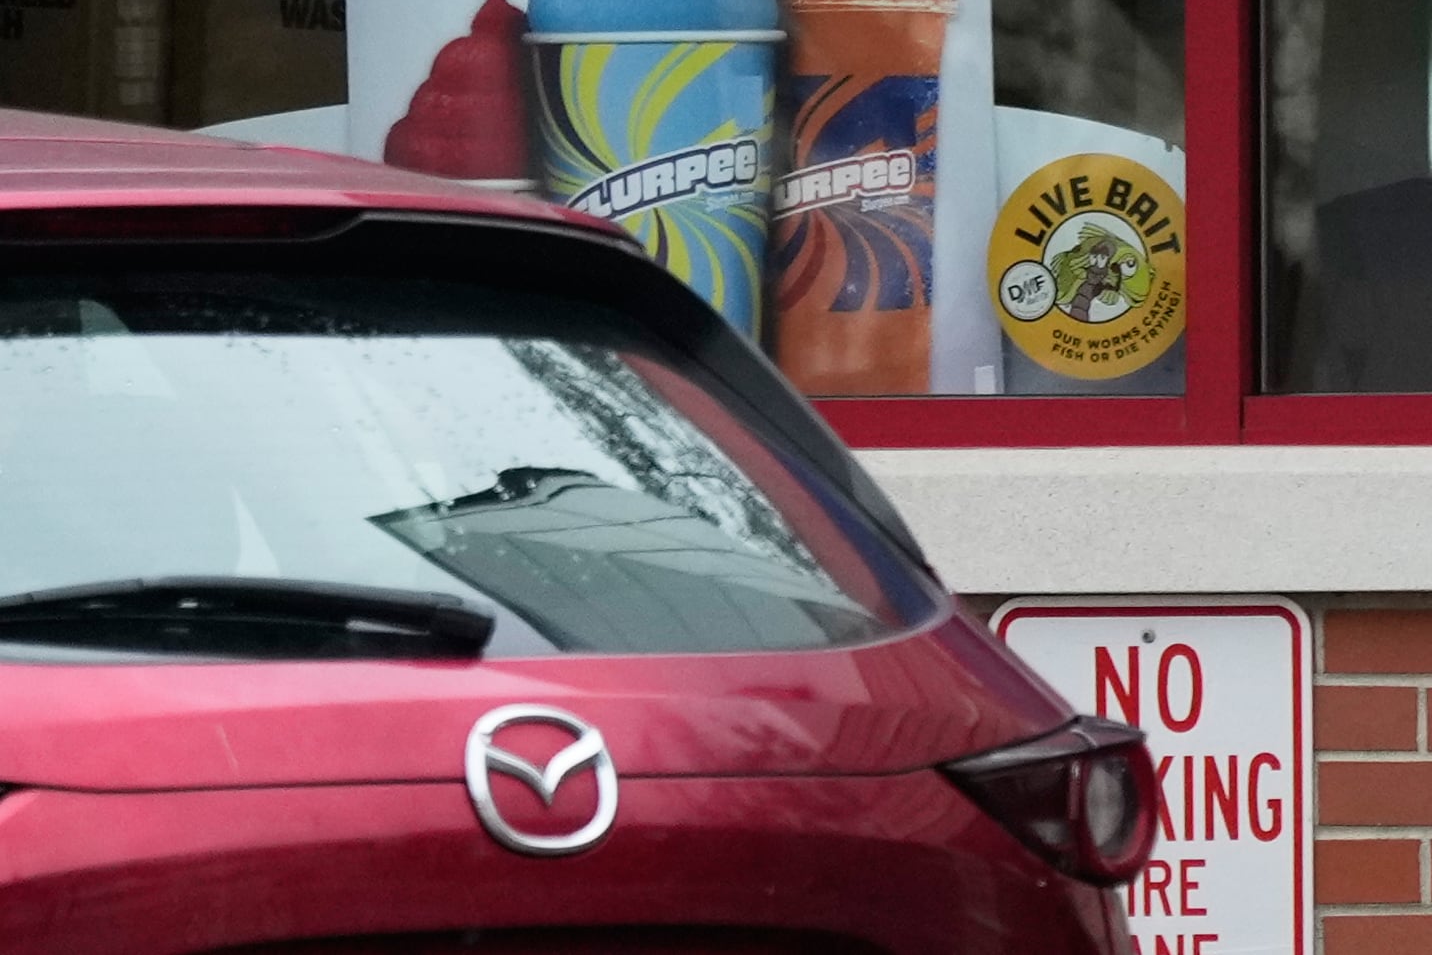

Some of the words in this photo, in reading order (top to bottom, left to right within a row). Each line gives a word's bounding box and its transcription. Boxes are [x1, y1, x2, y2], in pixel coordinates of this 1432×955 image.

[1015, 175, 1093, 247] LIVE
[1104, 176, 1181, 255] BAIT
[1052, 328, 1081, 347] OUR
[1088, 327, 1141, 350] WORMS
[1142, 281, 1172, 326] CATCH
[1052, 343, 1084, 362] FISH
[1091, 349, 1110, 363] OR
[1116, 343, 1140, 359] DIE
[1142, 290, 1182, 344] TRYING!
[1095, 643, 1203, 734] NO
[1157, 752, 1283, 842] KING
[1128, 859, 1208, 917] IRE
